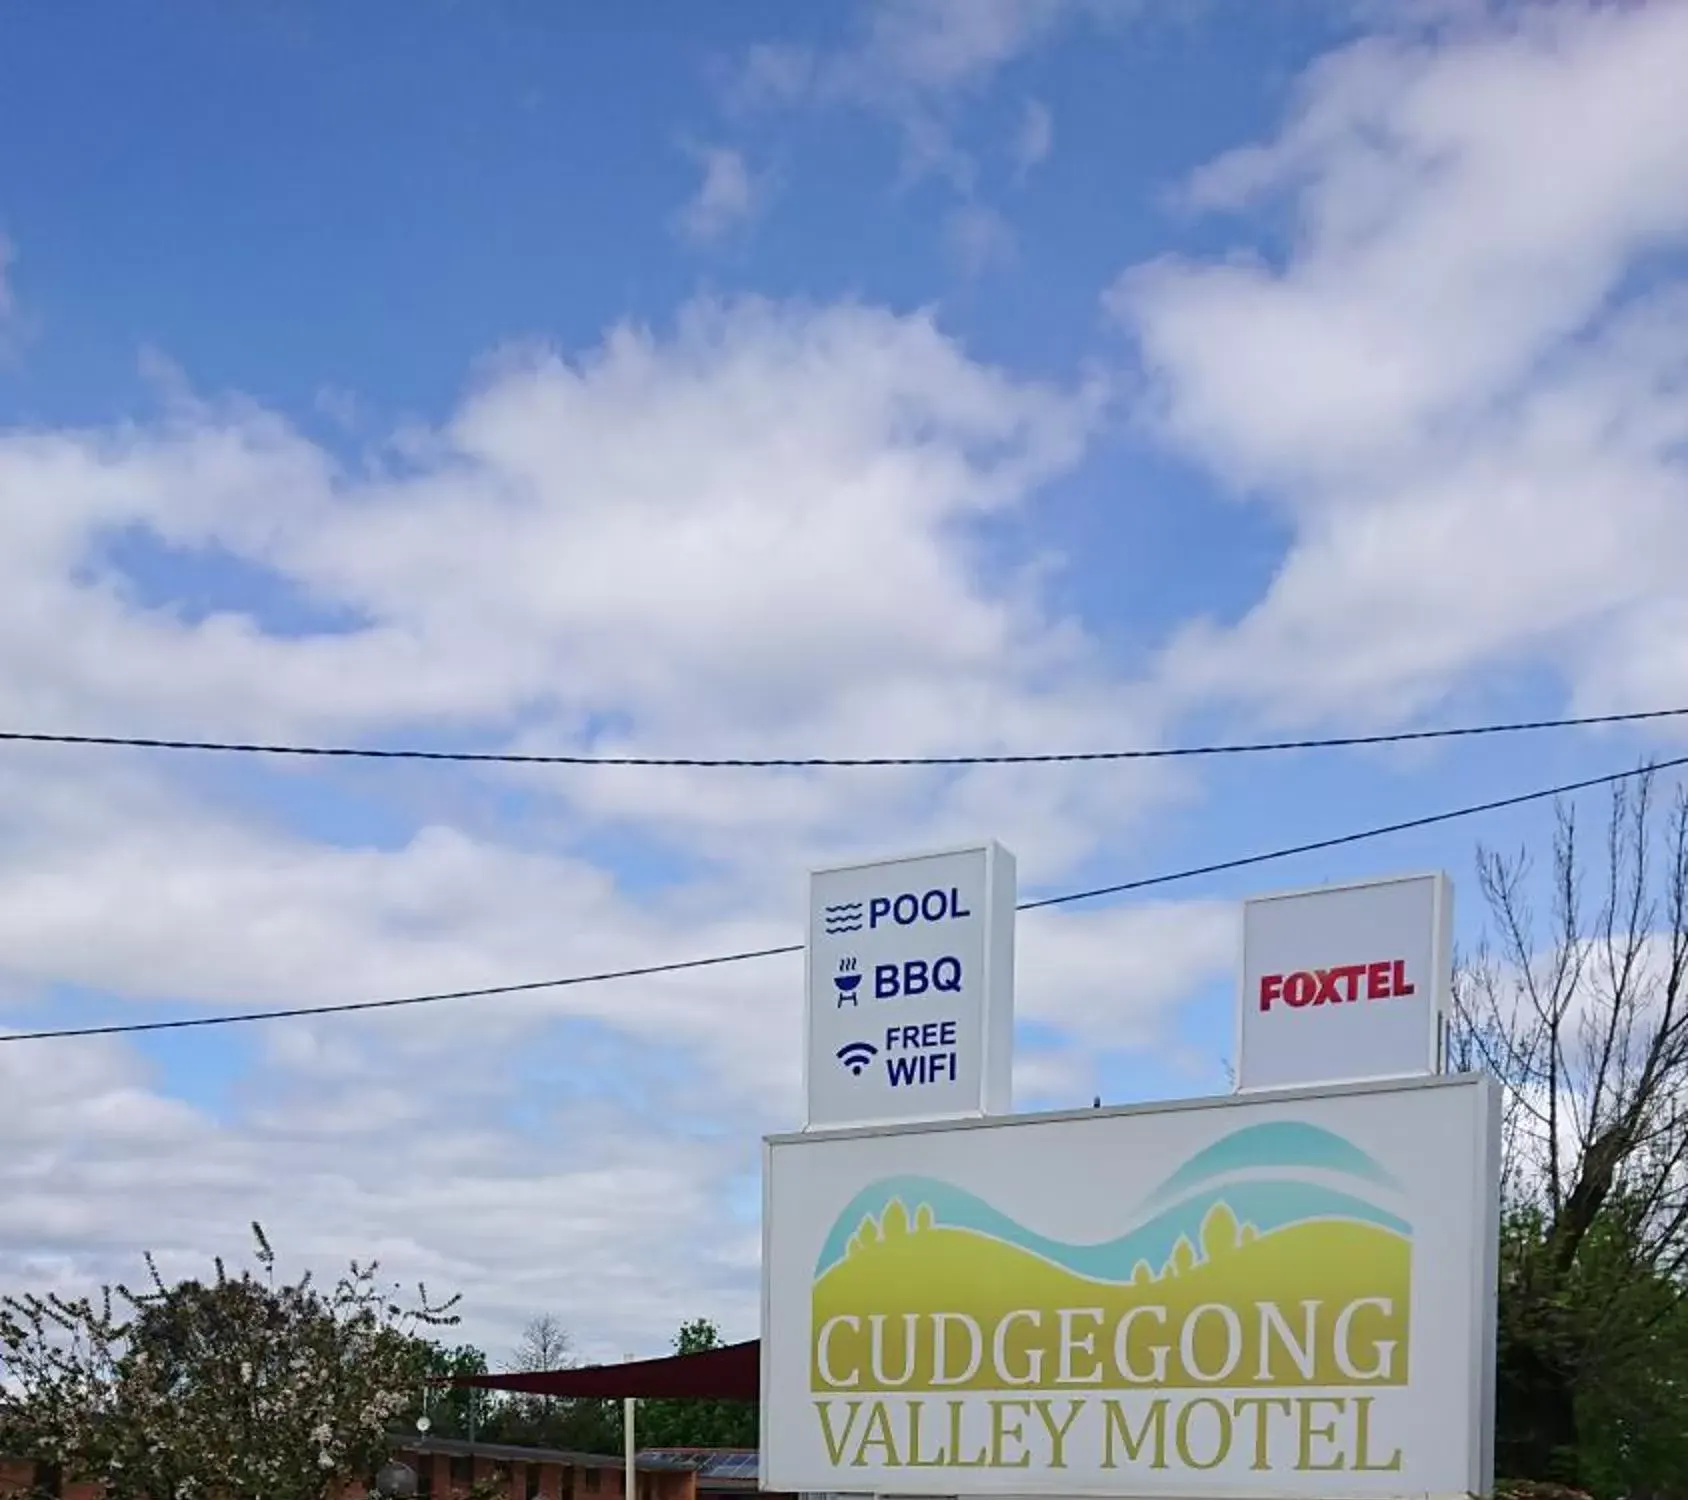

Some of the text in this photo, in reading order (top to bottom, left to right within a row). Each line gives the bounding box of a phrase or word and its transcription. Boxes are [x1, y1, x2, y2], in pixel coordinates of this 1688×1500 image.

[869, 888, 970, 928] POOL
[875, 956, 962, 999] BBQ
[1259, 960, 1415, 1012] FOXTEL
[886, 1021, 957, 1050] FREE
[887, 1053, 957, 1087] WIFI
[816, 1297, 1399, 1387] CUDGEGONG
[812, 1396, 1402, 1472] VALLEY MOTEL
